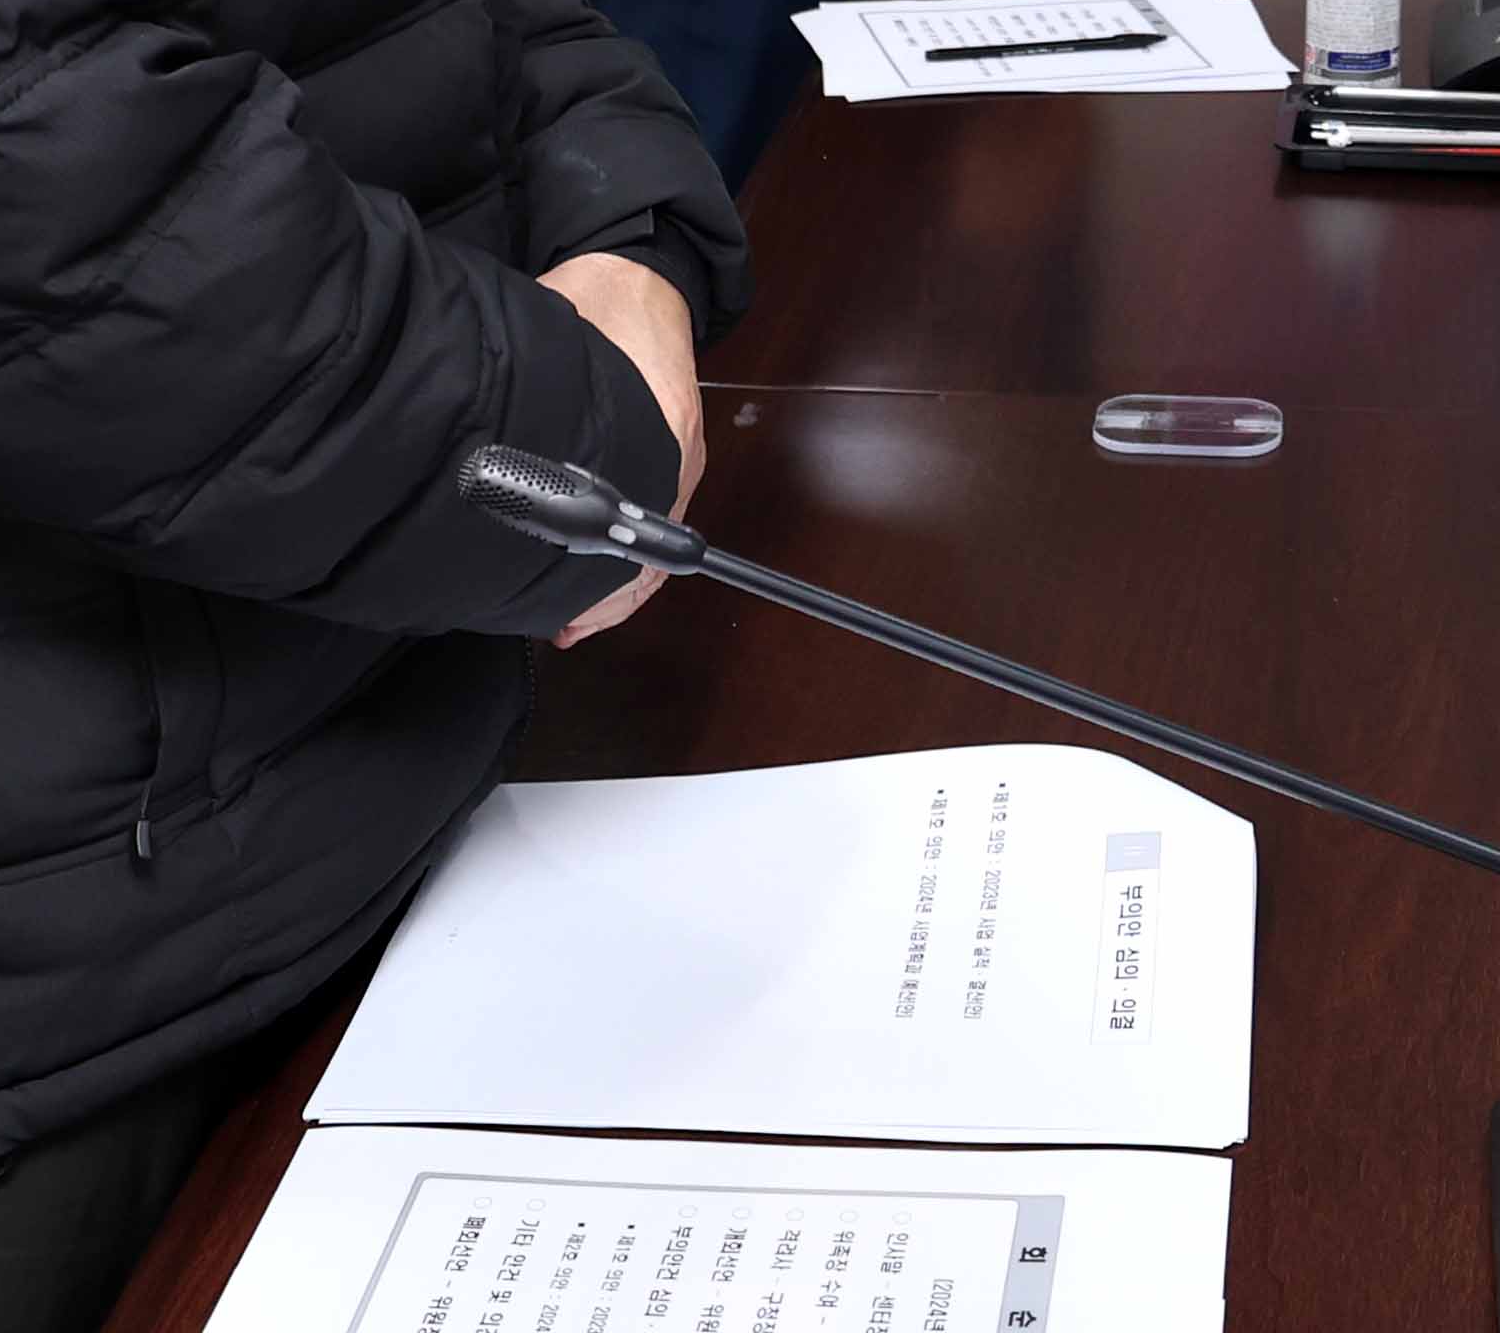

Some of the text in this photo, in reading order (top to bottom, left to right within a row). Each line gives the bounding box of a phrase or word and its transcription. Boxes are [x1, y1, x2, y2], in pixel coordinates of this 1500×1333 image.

[990, 792, 1010, 823] 제1호
[923, 836, 944, 861] 의안
[986, 830, 1006, 854] 의안
[915, 874, 938, 913] 2024년
[979, 870, 1003, 911] 2023년
[1116, 885, 1144, 937] 부의안
[975, 917, 997, 940] 사업
[1114, 947, 1141, 981] 심의
[1109, 998, 1138, 1030] 의결
[444, 1216, 487, 1272] 폐회선언
[510, 1218, 541, 1247] 기타
[561, 1233, 587, 1261] 제2호
[611, 1235, 637, 1264] 제1호
[656, 1226, 693, 1280] 부의안건
[711, 1228, 748, 1282] 개회선언
[770, 1229, 802, 1270] 격려사
[825, 1231, 856, 1272] 위촉장
[880, 1232, 909, 1274] 인사말
[496, 1254, 527, 1281] 안건
[549, 1267, 573, 1290] 의안
[601, 1269, 625, 1292] 의안
[487, 1289, 514, 1304] 및
[814, 1279, 843, 1308] 수여
[1007, 1246, 1048, 1328] 회 순
[644, 1289, 673, 1317] 심의
